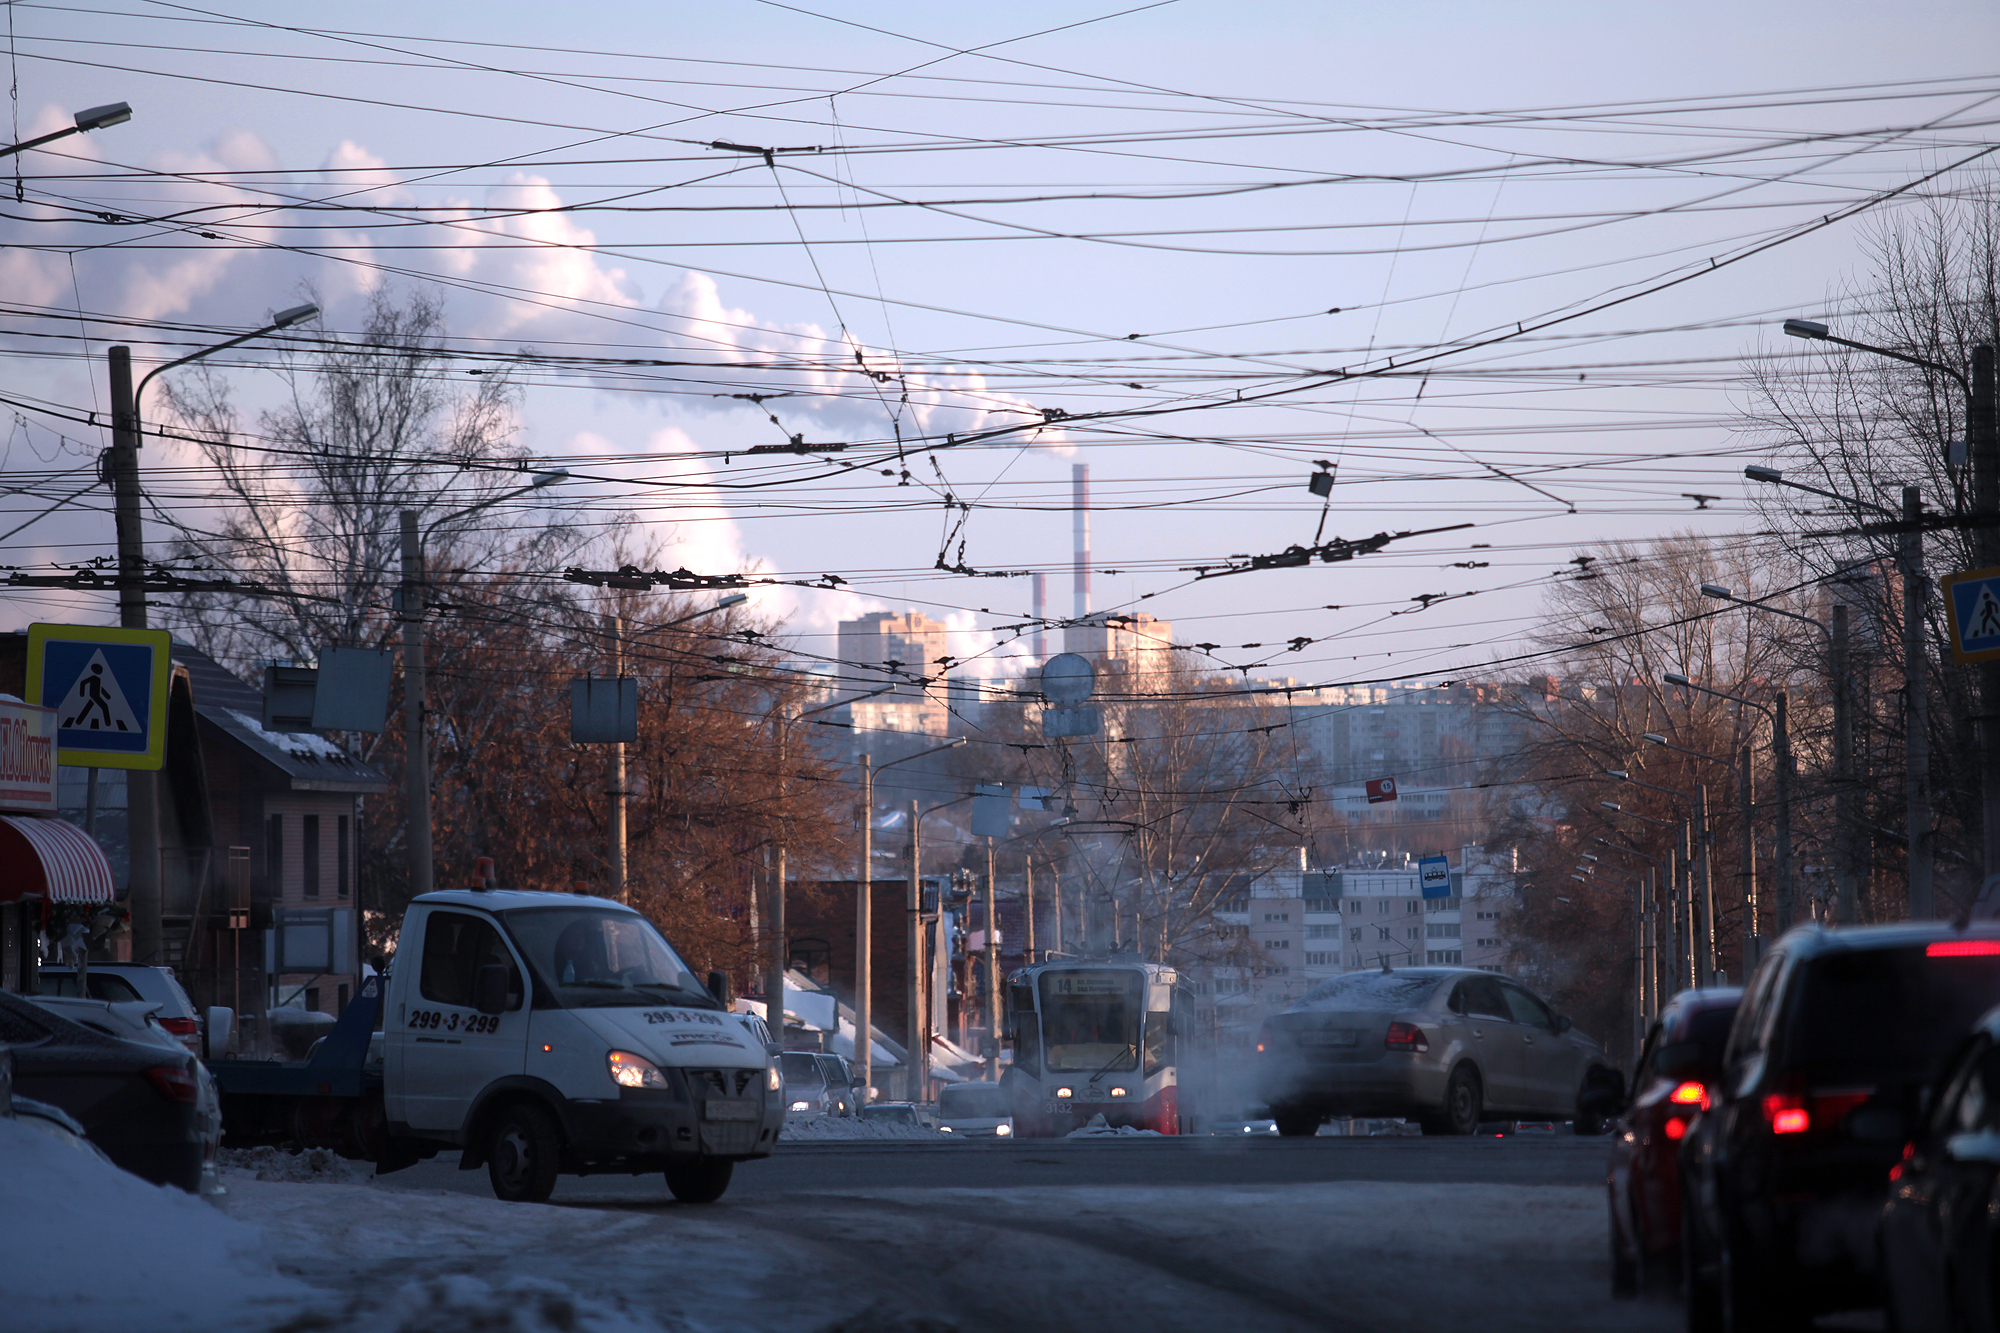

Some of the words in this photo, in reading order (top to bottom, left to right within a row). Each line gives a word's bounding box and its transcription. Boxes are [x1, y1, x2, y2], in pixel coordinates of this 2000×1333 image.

[1057, 978, 1072, 993] 14
[408, 1010, 442, 1029] 299
[447, 1013, 460, 1031] 3
[465, 1014, 500, 1034] 299
[643, 1011, 676, 1024] 299
[695, 1013, 724, 1026] 299
[1046, 1103, 1073, 1114] 3132
